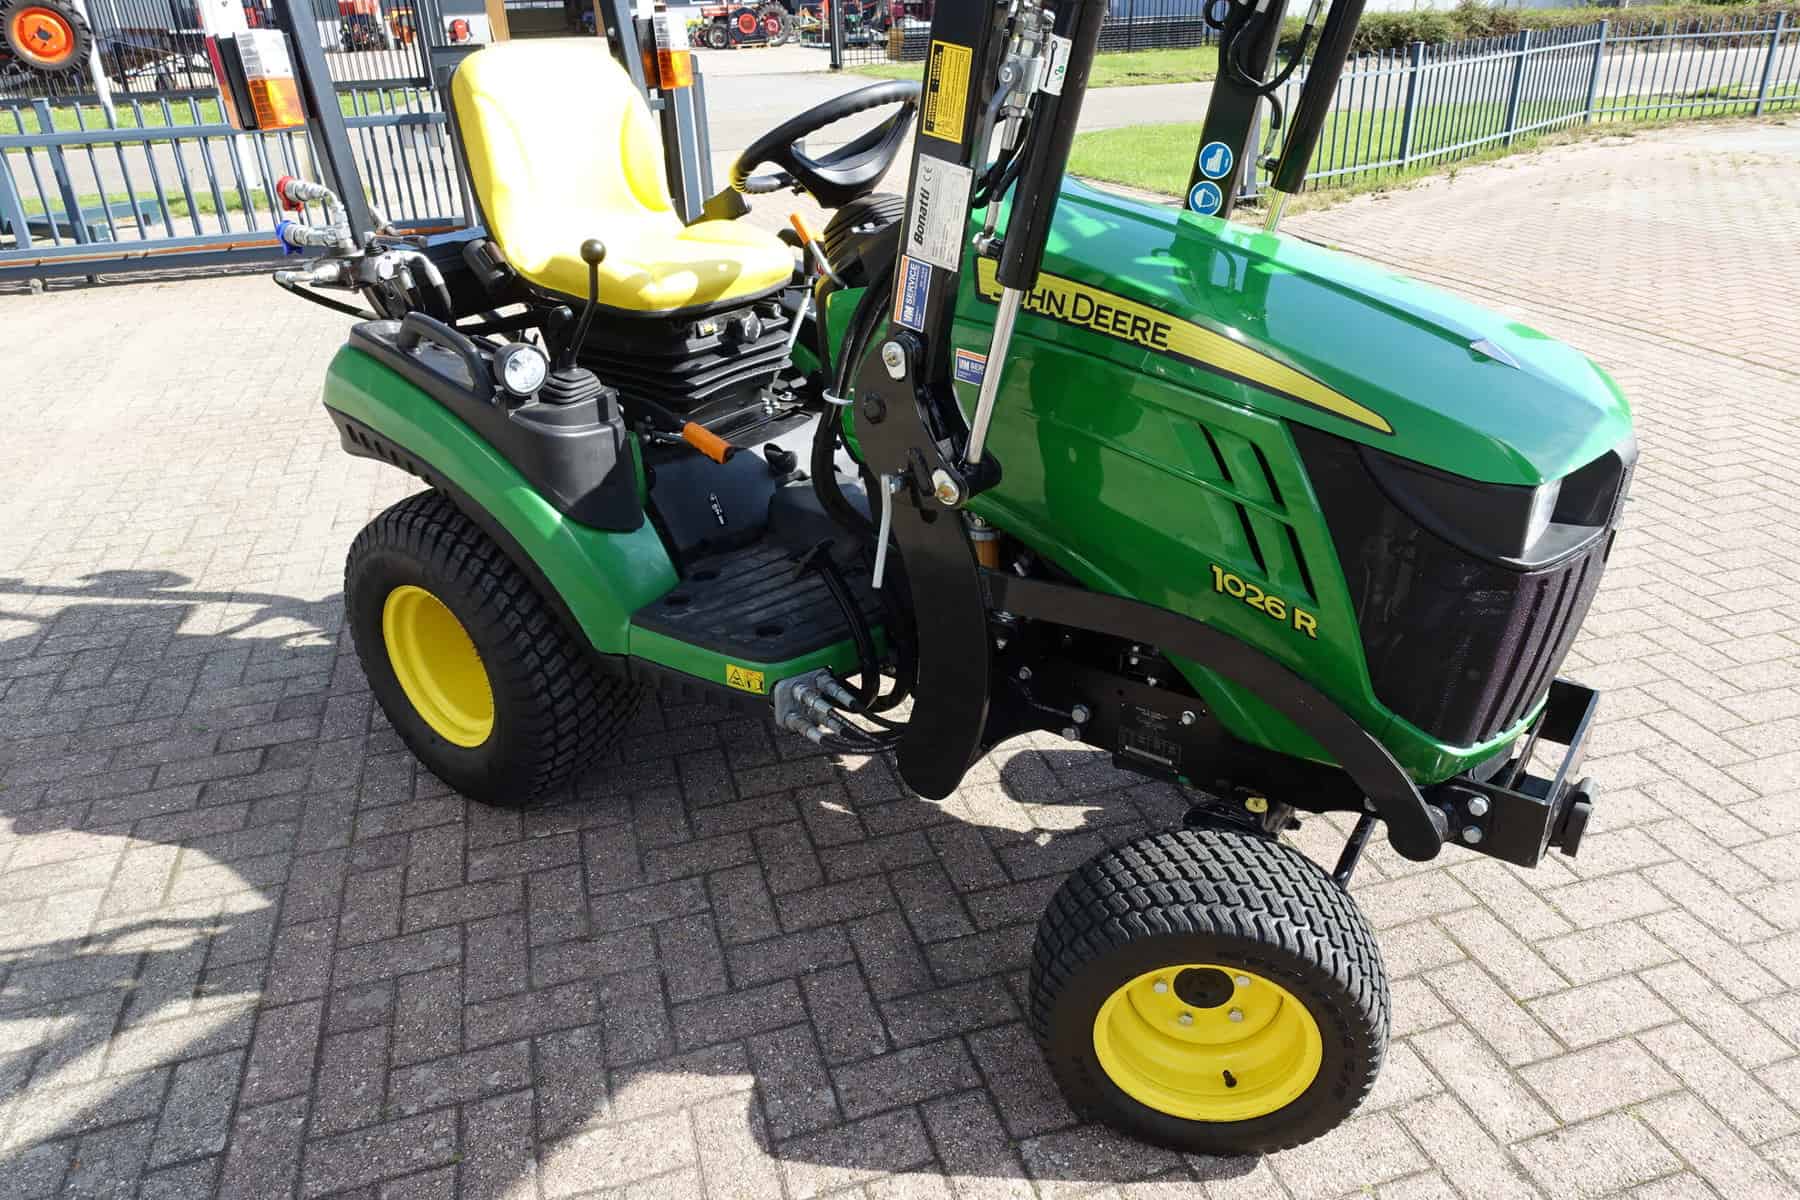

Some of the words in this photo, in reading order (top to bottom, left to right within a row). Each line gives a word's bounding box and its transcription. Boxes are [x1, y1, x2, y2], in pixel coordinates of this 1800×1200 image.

[913, 189, 931, 247] Bonatti
[907, 262, 920, 306] SERVICE
[1071, 292, 1172, 348] DEERE
[1212, 564, 1287, 620] 1026
[1294, 607, 1318, 639] R
